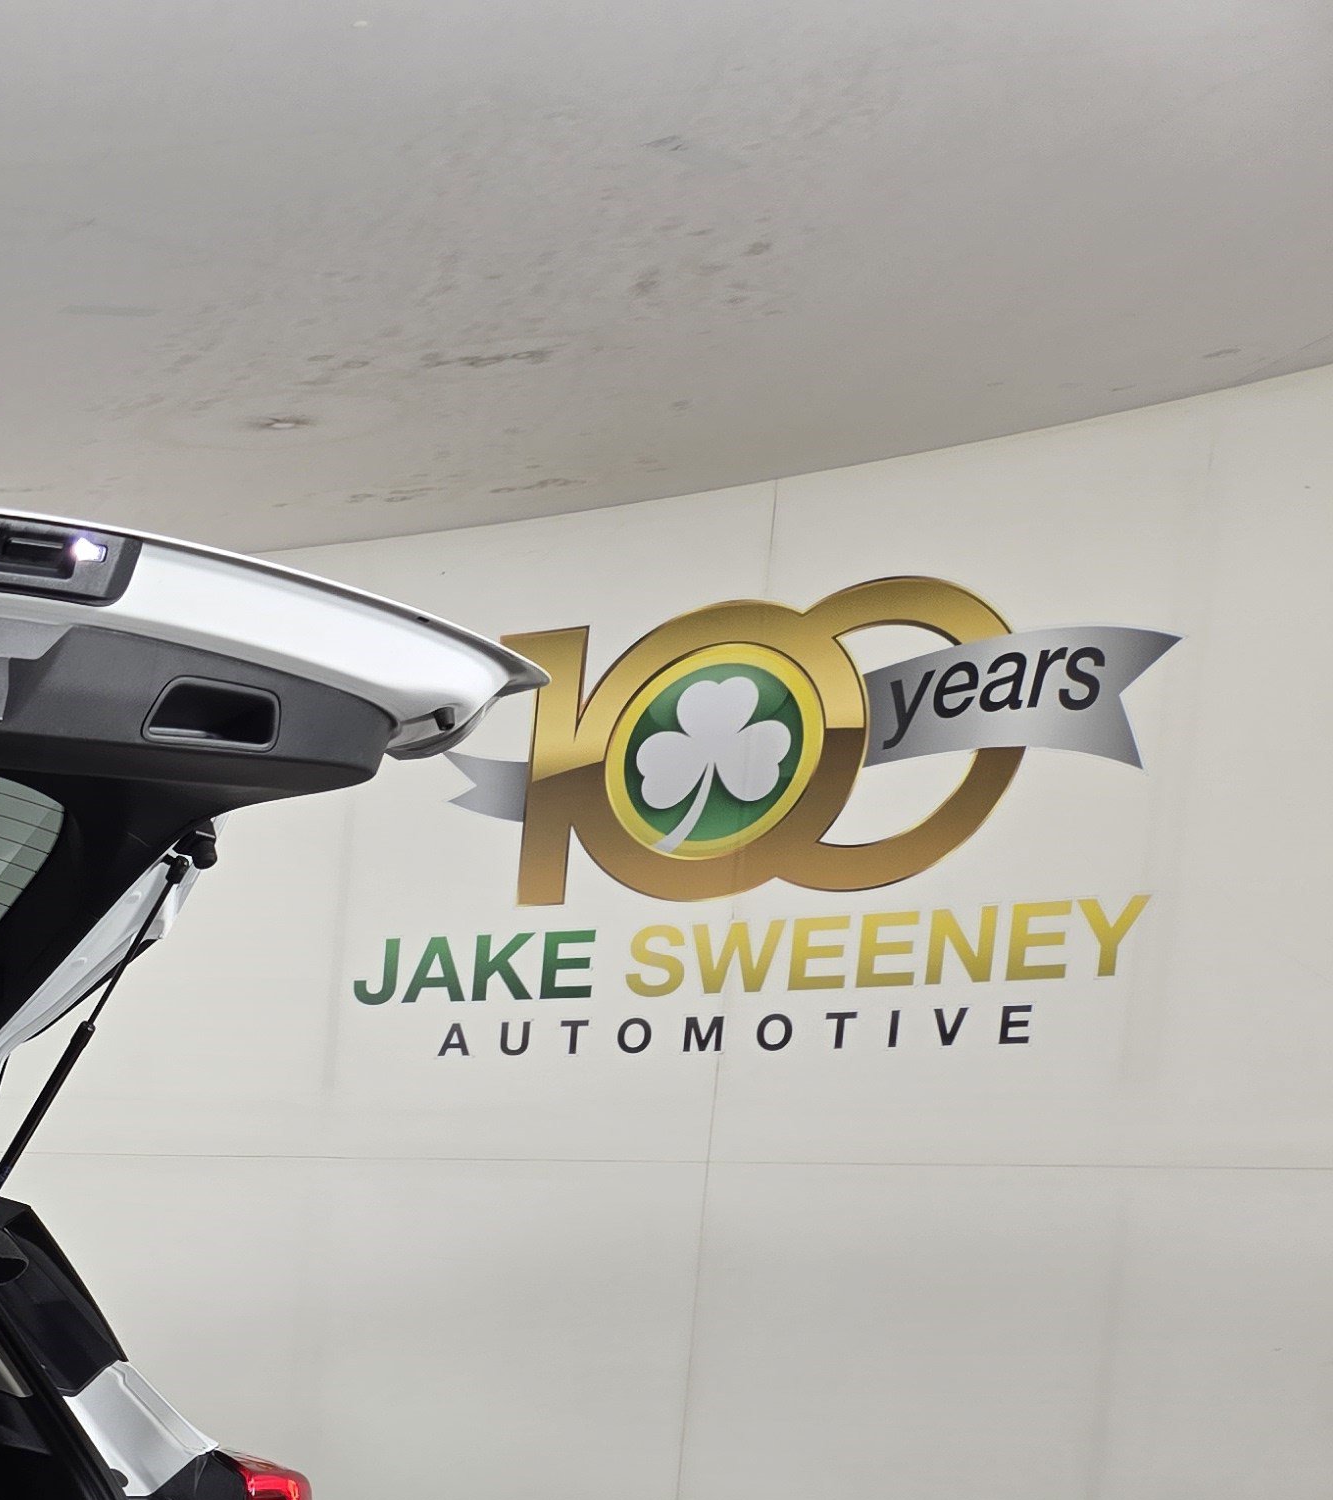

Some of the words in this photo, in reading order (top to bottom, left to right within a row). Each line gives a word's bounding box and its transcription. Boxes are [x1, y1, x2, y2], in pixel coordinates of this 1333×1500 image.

[882, 645, 1107, 750] years
[353, 929, 597, 1006] JAKE
[625, 894, 1152, 998] SWEENEY
[437, 1004, 1035, 1057] AUTOMOTIVE
